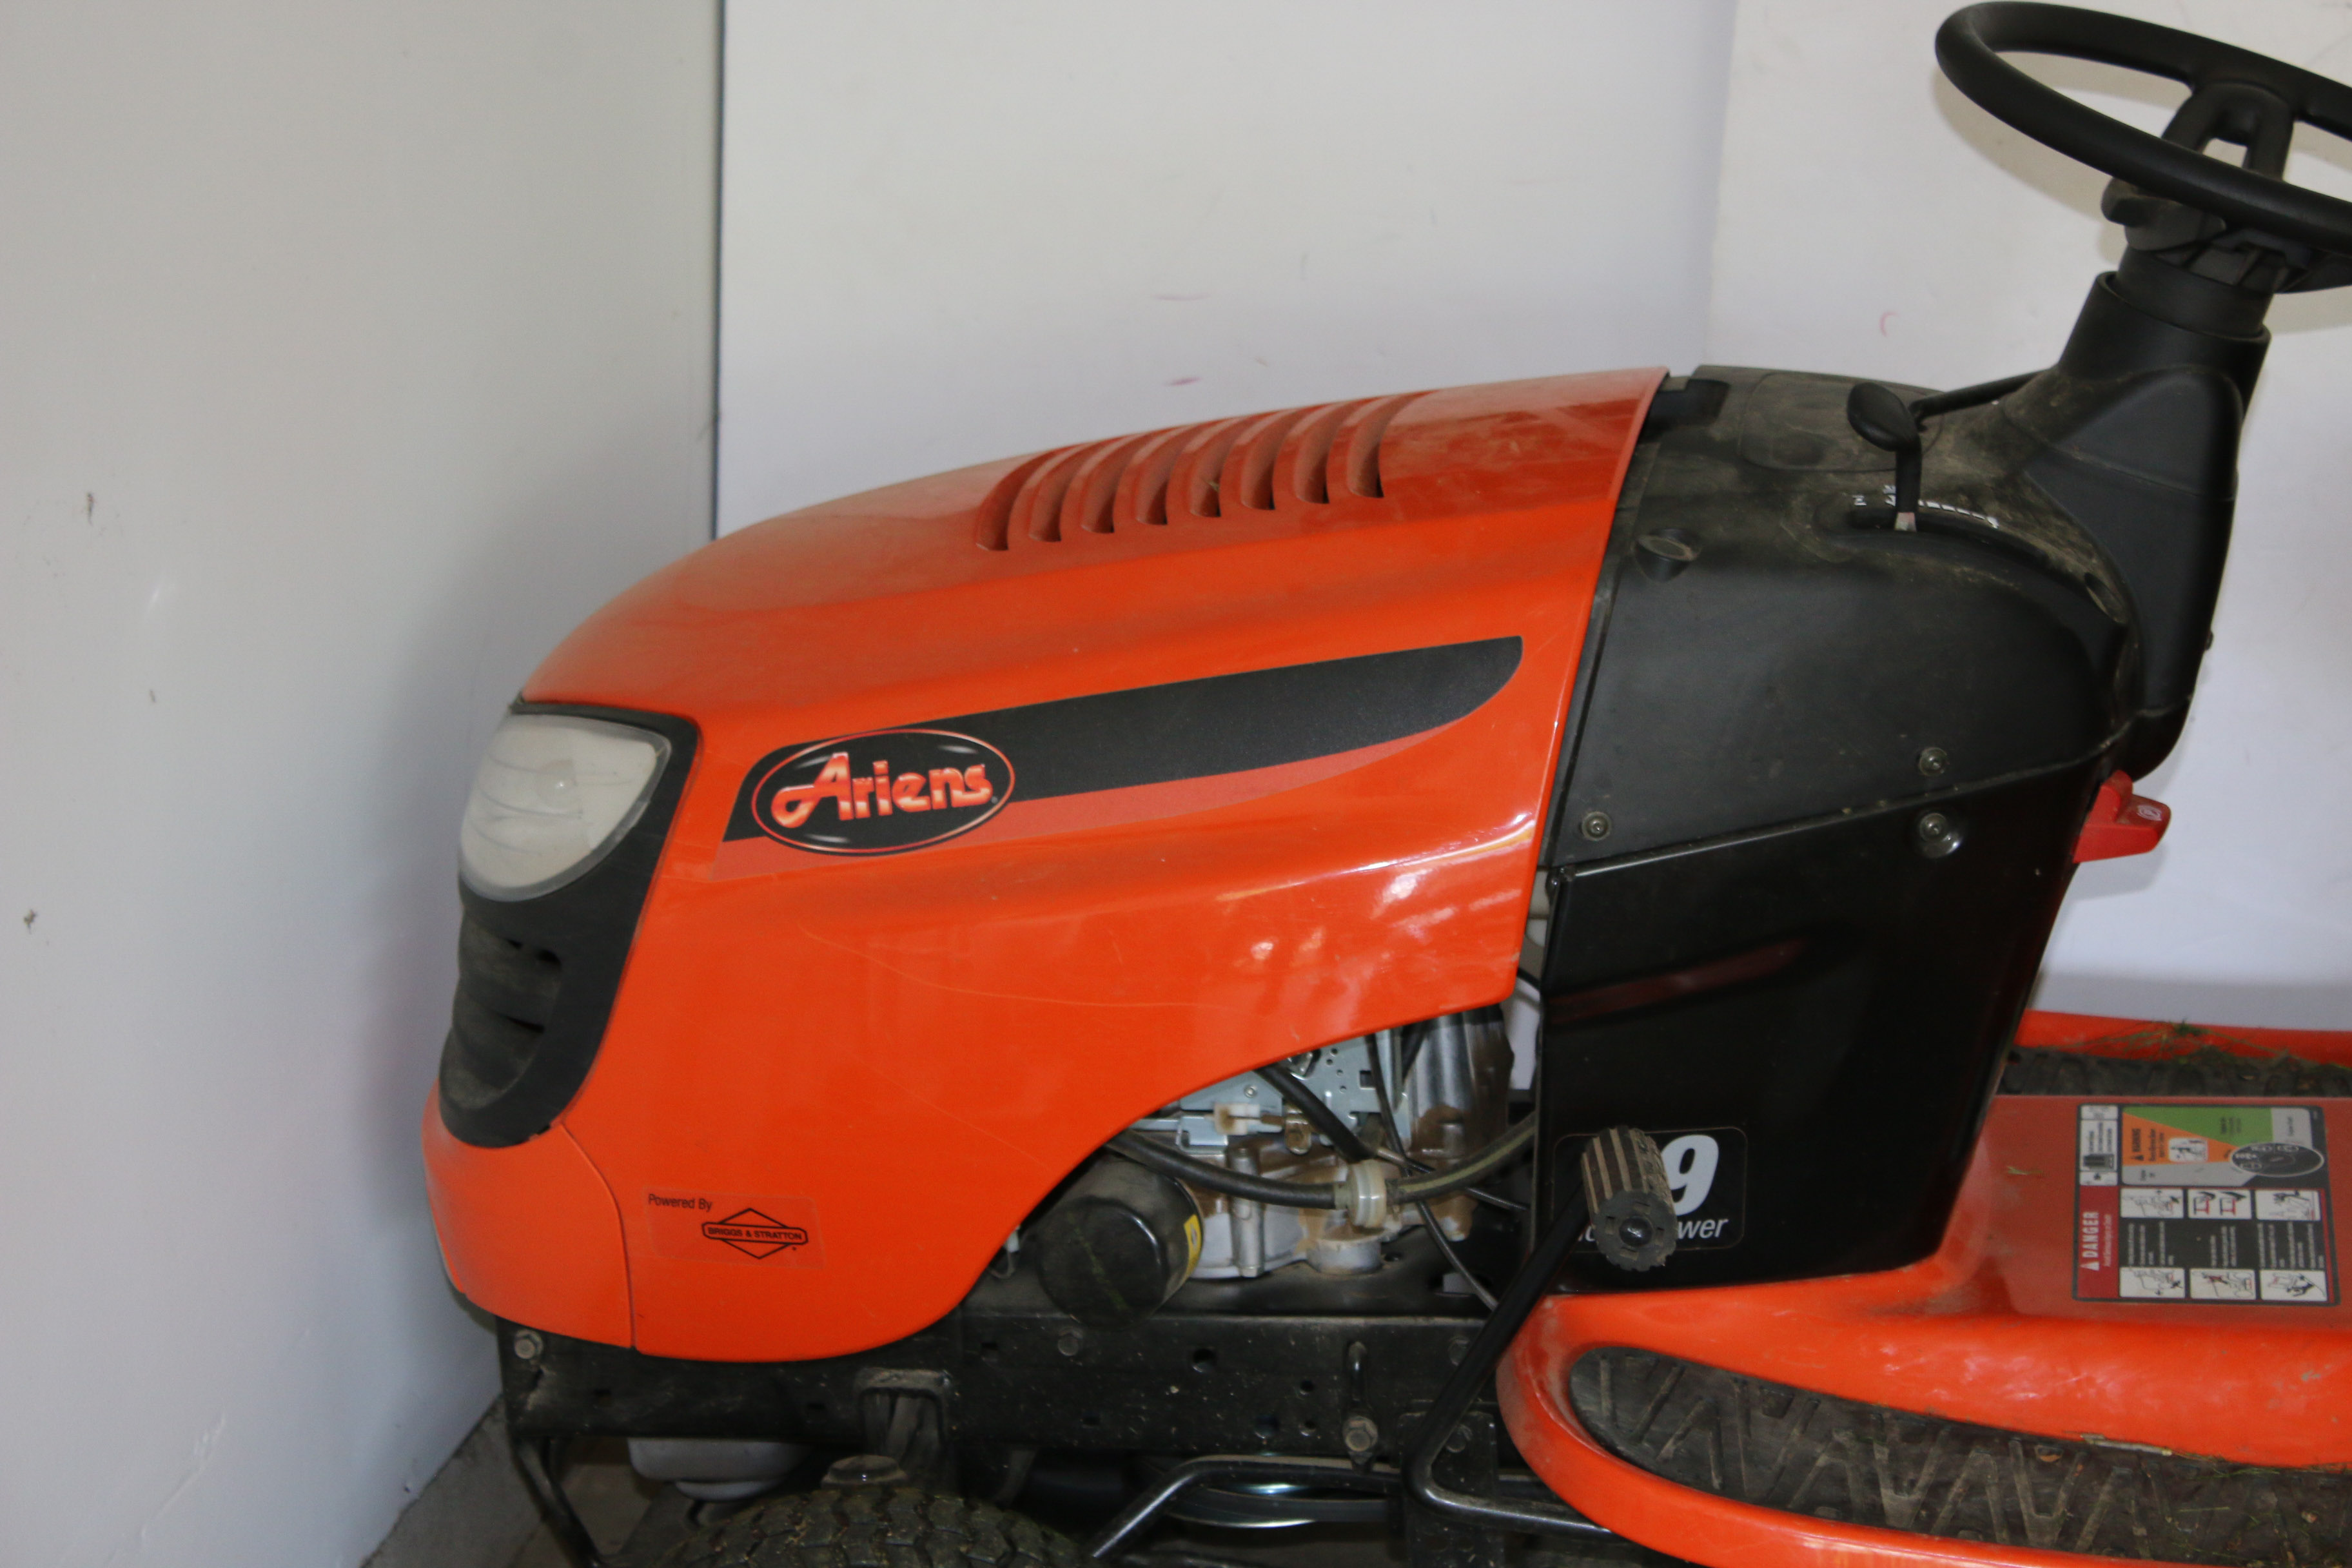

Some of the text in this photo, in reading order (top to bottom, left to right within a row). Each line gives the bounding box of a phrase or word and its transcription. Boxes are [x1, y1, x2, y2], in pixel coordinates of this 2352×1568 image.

[770, 752, 994, 828] Ariens
[648, 1193, 712, 1212] Powered By
[707, 1226, 743, 1237] BRIGGS
[754, 1231, 802, 1240] STRATTON
[2082, 1211, 2099, 1259] DANGER
